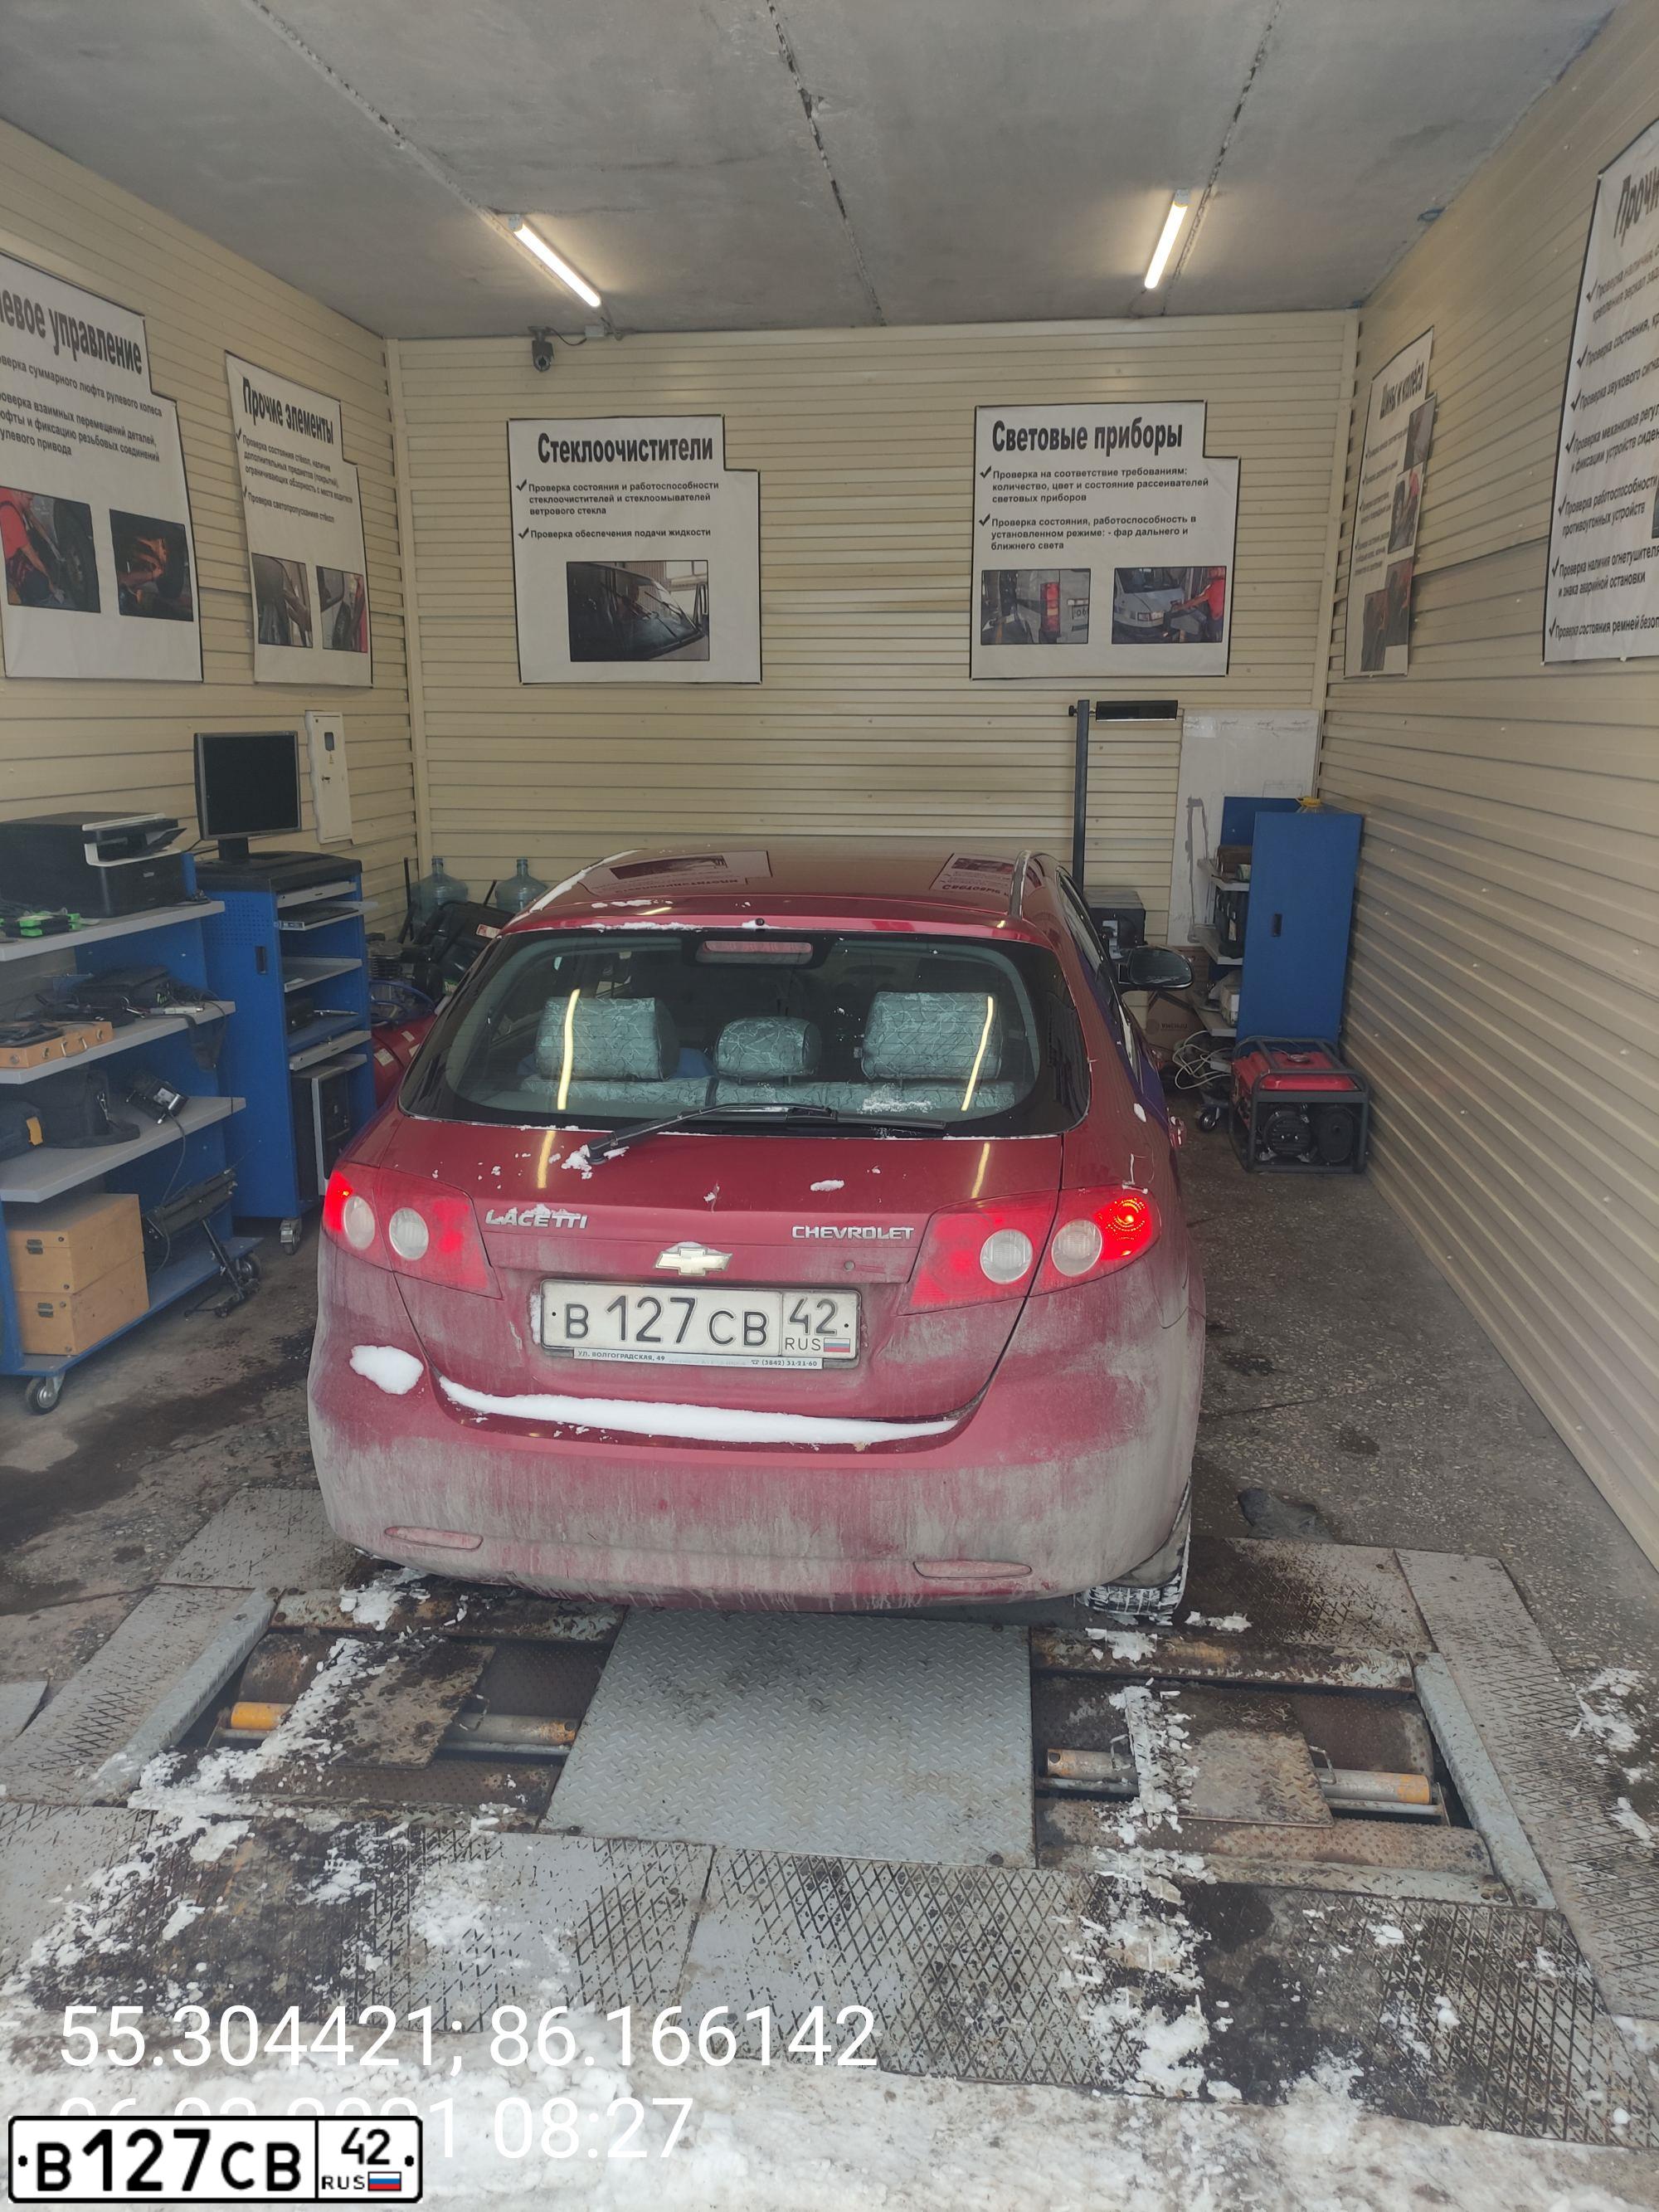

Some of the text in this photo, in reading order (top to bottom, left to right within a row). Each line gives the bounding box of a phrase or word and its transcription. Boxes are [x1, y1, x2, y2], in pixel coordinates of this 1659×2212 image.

[0, 290, 142, 375] евое управление
[29, 363, 77, 389] суммарного
[80, 382, 105, 399] люфта
[106, 391, 139, 410] рулевого
[140, 402, 162, 417] колеса
[1608, 368, 1641, 395] звукового
[0, 394, 32, 410] оверка
[34, 402, 75, 421] взаимных
[76, 414, 125, 437] перемещений
[243, 377, 333, 445] Прочие элементы
[27, 417, 32, 427] и
[35, 417, 76, 440] фиксацию
[78, 431, 118, 452] резьбовых
[119, 443, 160, 462] соединений
[242, 434, 267, 451] Проверка
[992, 417, 1183, 457] Световые приборы
[37, 438, 72, 456] привода
[538, 432, 713, 464] Стеклоочистители
[1606, 436, 1636, 464] устройств
[993, 470, 1038, 480] Проверка
[1054, 469, 1118, 478] соответствие
[1121, 467, 1187, 477] требованиям:
[528, 483, 571, 493] Проверка
[573, 483, 619, 491] состояния
[630, 481, 718, 492] работоспособности
[992, 482, 1049, 491] количество,
[1052, 482, 1073, 491] цвет
[1085, 480, 1134, 489] состояние
[1136, 478, 1209, 490] рассеивателей
[1593, 475, 1657, 510] работоспособности
[247, 492, 272, 508] Проверка
[529, 494, 614, 504] стеклоочистителей
[625, 493, 711, 502] стеклоомывателей
[992, 494, 1087, 504] световых приборов
[530, 507, 606, 516] ветрового стекла
[1612, 500, 1646, 524] устройств
[992, 518, 1037, 529] Проверка
[1039, 518, 1091, 527] состояния,
[1093, 515, 1187, 526] работоспособность
[531, 529, 711, 539] Проверка обеспечения подачи жидкости
[991, 529, 1063, 538] установленном
[1066, 529, 1106, 538] режиме:
[1113, 529, 1133, 538] фар
[1136, 528, 1180, 537] дальнего
[991, 541, 1035, 551] ближнего
[1559, 560, 1587, 579] Проверка
[1559, 587, 1563, 598] и
[1609, 570, 1646, 590] остановки
[1555, 623, 1579, 639] Проверка
[1612, 616, 1639, 636] ремней
[484, 1209, 589, 1229] LACETTI
[791, 1225, 914, 1240] CHEVROLET
[790, 1298, 836, 1335] 42
[786, 1337, 820, 1351] RUS
[591, 1351, 654, 1362] ВОЛГОГРАДСКАЯ,
